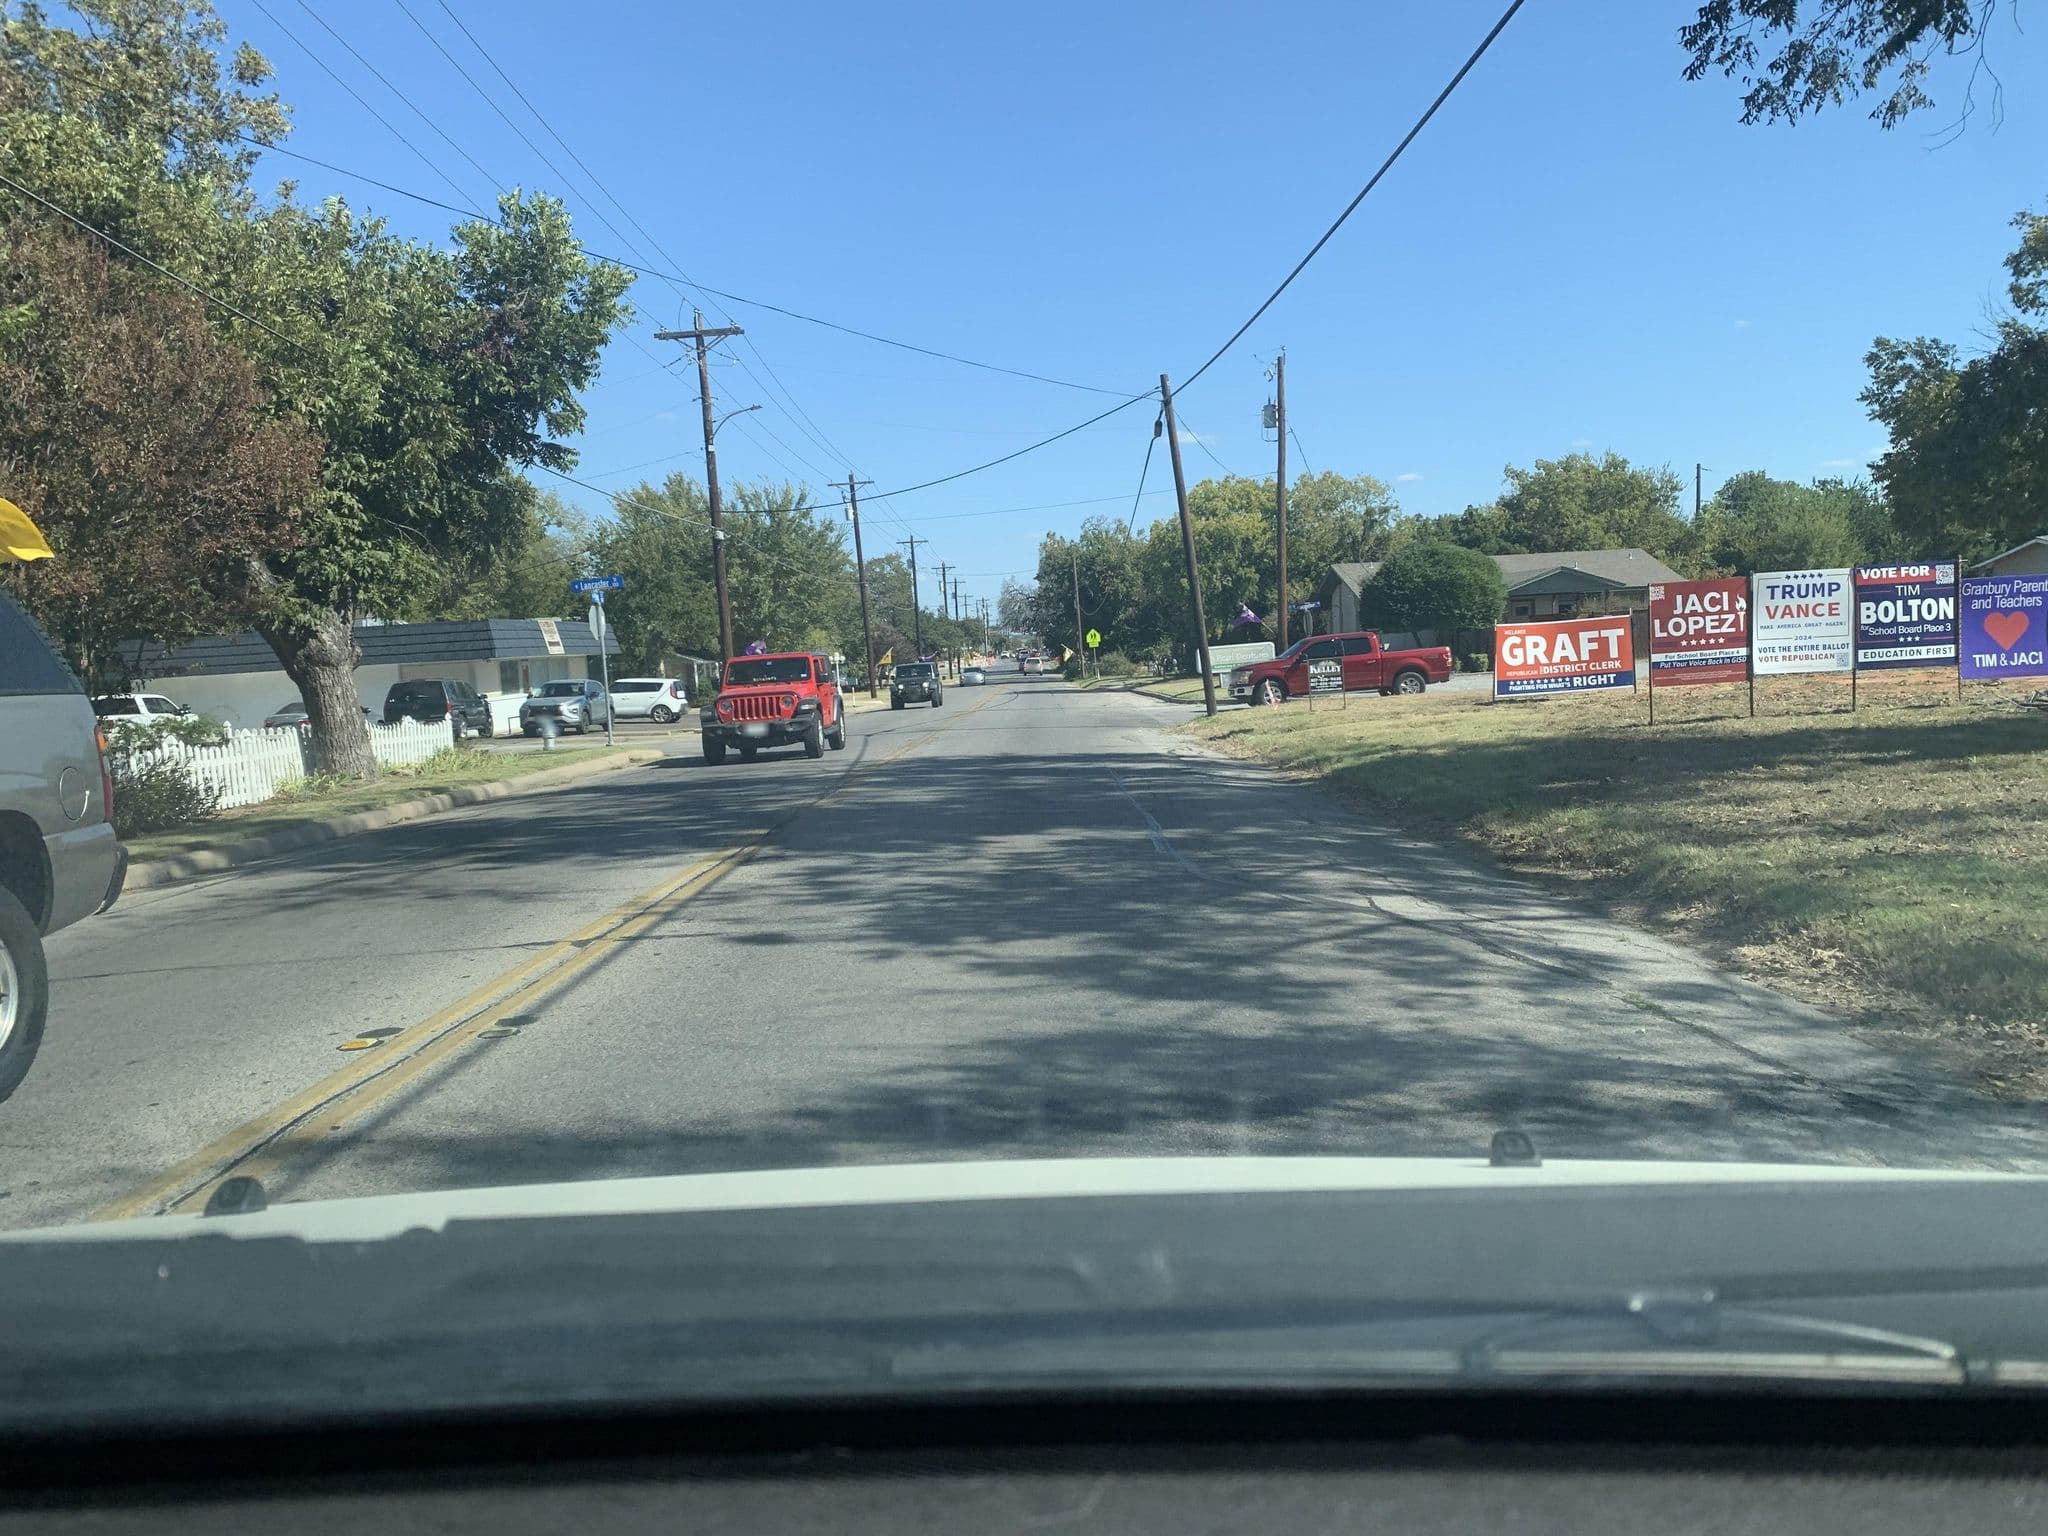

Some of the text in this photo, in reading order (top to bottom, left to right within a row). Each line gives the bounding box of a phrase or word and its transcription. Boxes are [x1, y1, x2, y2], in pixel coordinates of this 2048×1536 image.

[1860, 565, 1930, 580] VOTE FOR
[580, 579, 609, 590] Lancaster
[1766, 582, 1842, 600] TRUMP
[1895, 584, 1920, 596] TIM
[1962, 581, 2011, 597] Granbury
[1673, 591, 1729, 615] JACI
[1971, 594, 2043, 609] and Teachers
[1765, 602, 1841, 620] VANCE
[1860, 597, 1954, 625] BOLTON
[1654, 614, 1736, 638] LOPEZ
[1868, 626, 1897, 636] School
[1898, 624, 1922, 634] Board
[1924, 623, 1945, 633] Place
[1945, 623, 1951, 632] 3
[1501, 628, 1625, 666] GRAFT
[1758, 643, 1850, 654] VOTE THE ENTIRE BALLOT
[1863, 646, 1953, 659] EDUCATION FIRST
[1660, 661, 1671, 669] Put
[1758, 653, 1835, 663] VOTE REPUBLICAN
[1972, 651, 2043, 668] TIM & JACI
[1543, 663, 1588, 674] DISTRICT
[1589, 660, 1622, 671] CLERK
[1573, 674, 1616, 687] RIGHT
